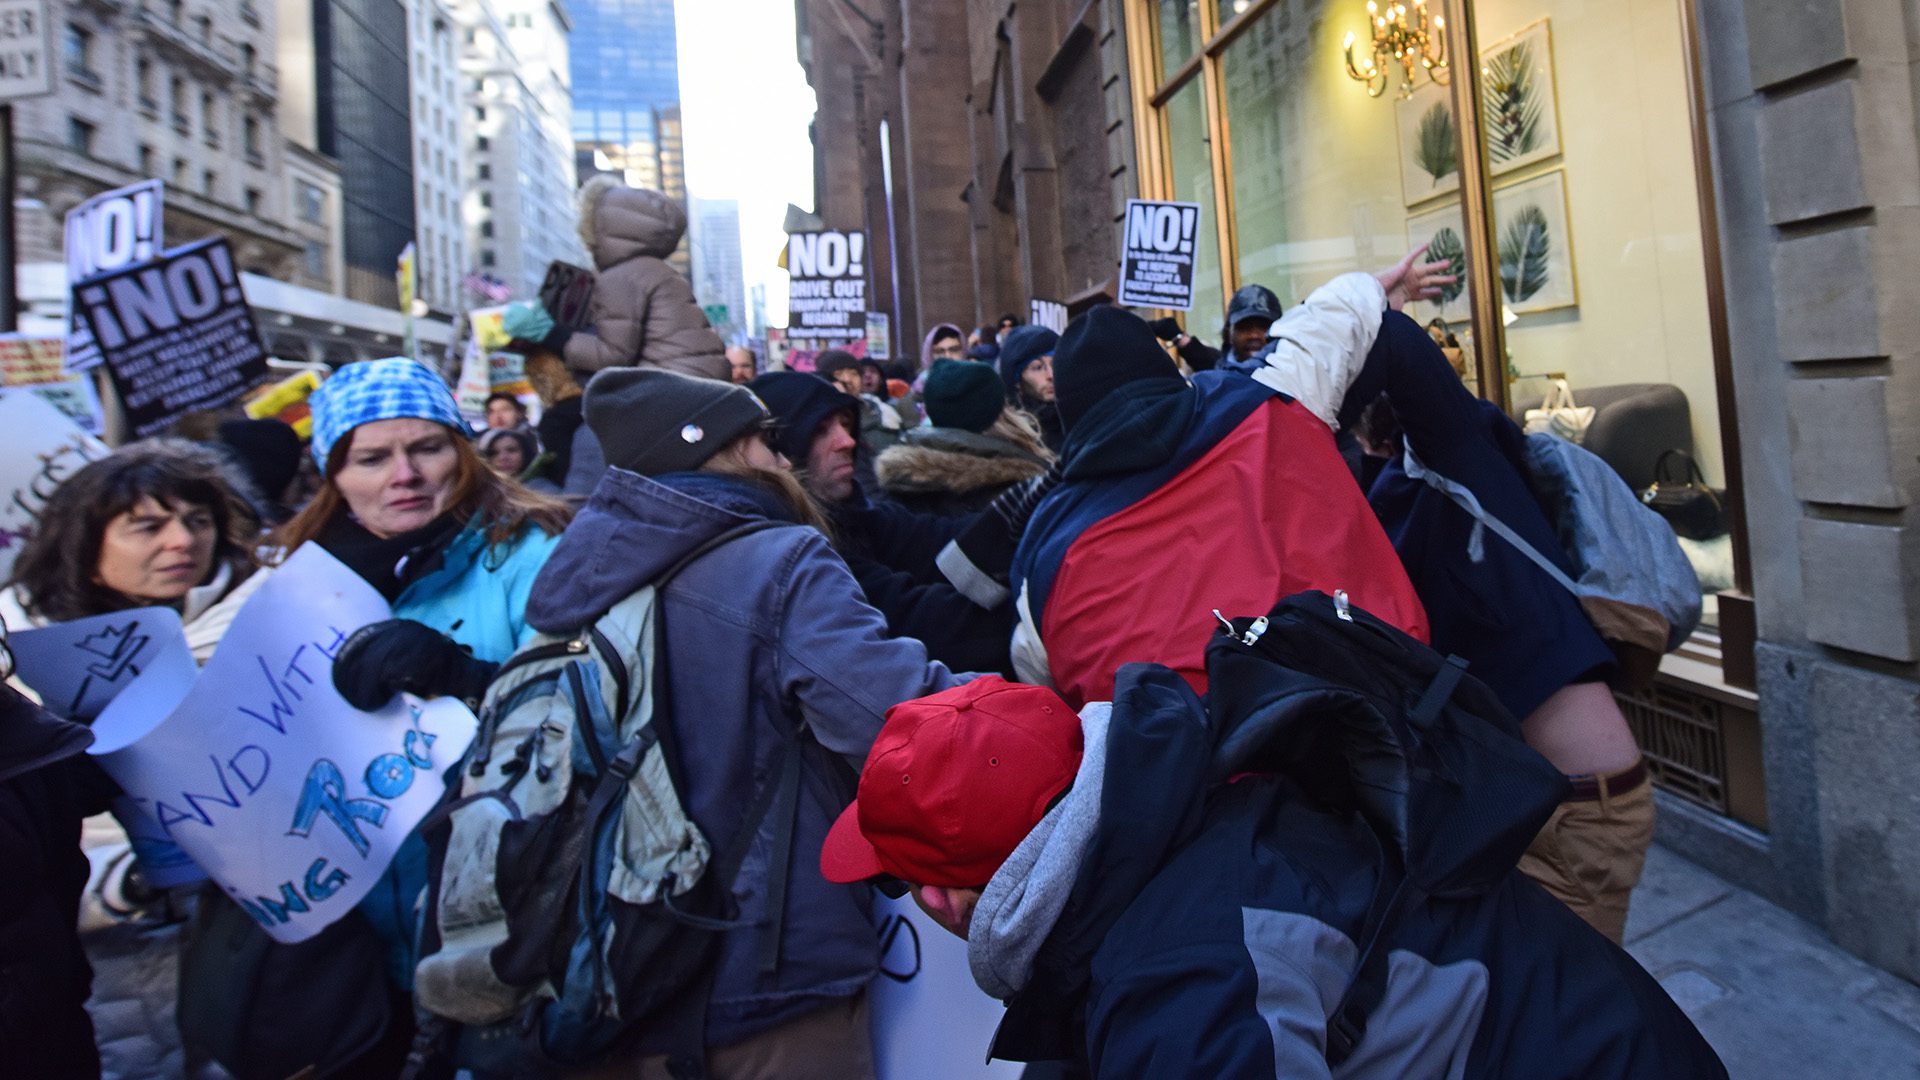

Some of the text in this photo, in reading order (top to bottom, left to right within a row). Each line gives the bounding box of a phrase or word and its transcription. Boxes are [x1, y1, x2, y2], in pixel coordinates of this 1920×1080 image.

[789, 231, 864, 277] NO!
[1129, 205, 1195, 253] NO!
[80, 245, 241, 348] ¡NO!
[790, 279, 866, 298] DRIVE OUT
[156, 744, 271, 838] AND
[241, 857, 352, 926] ING
